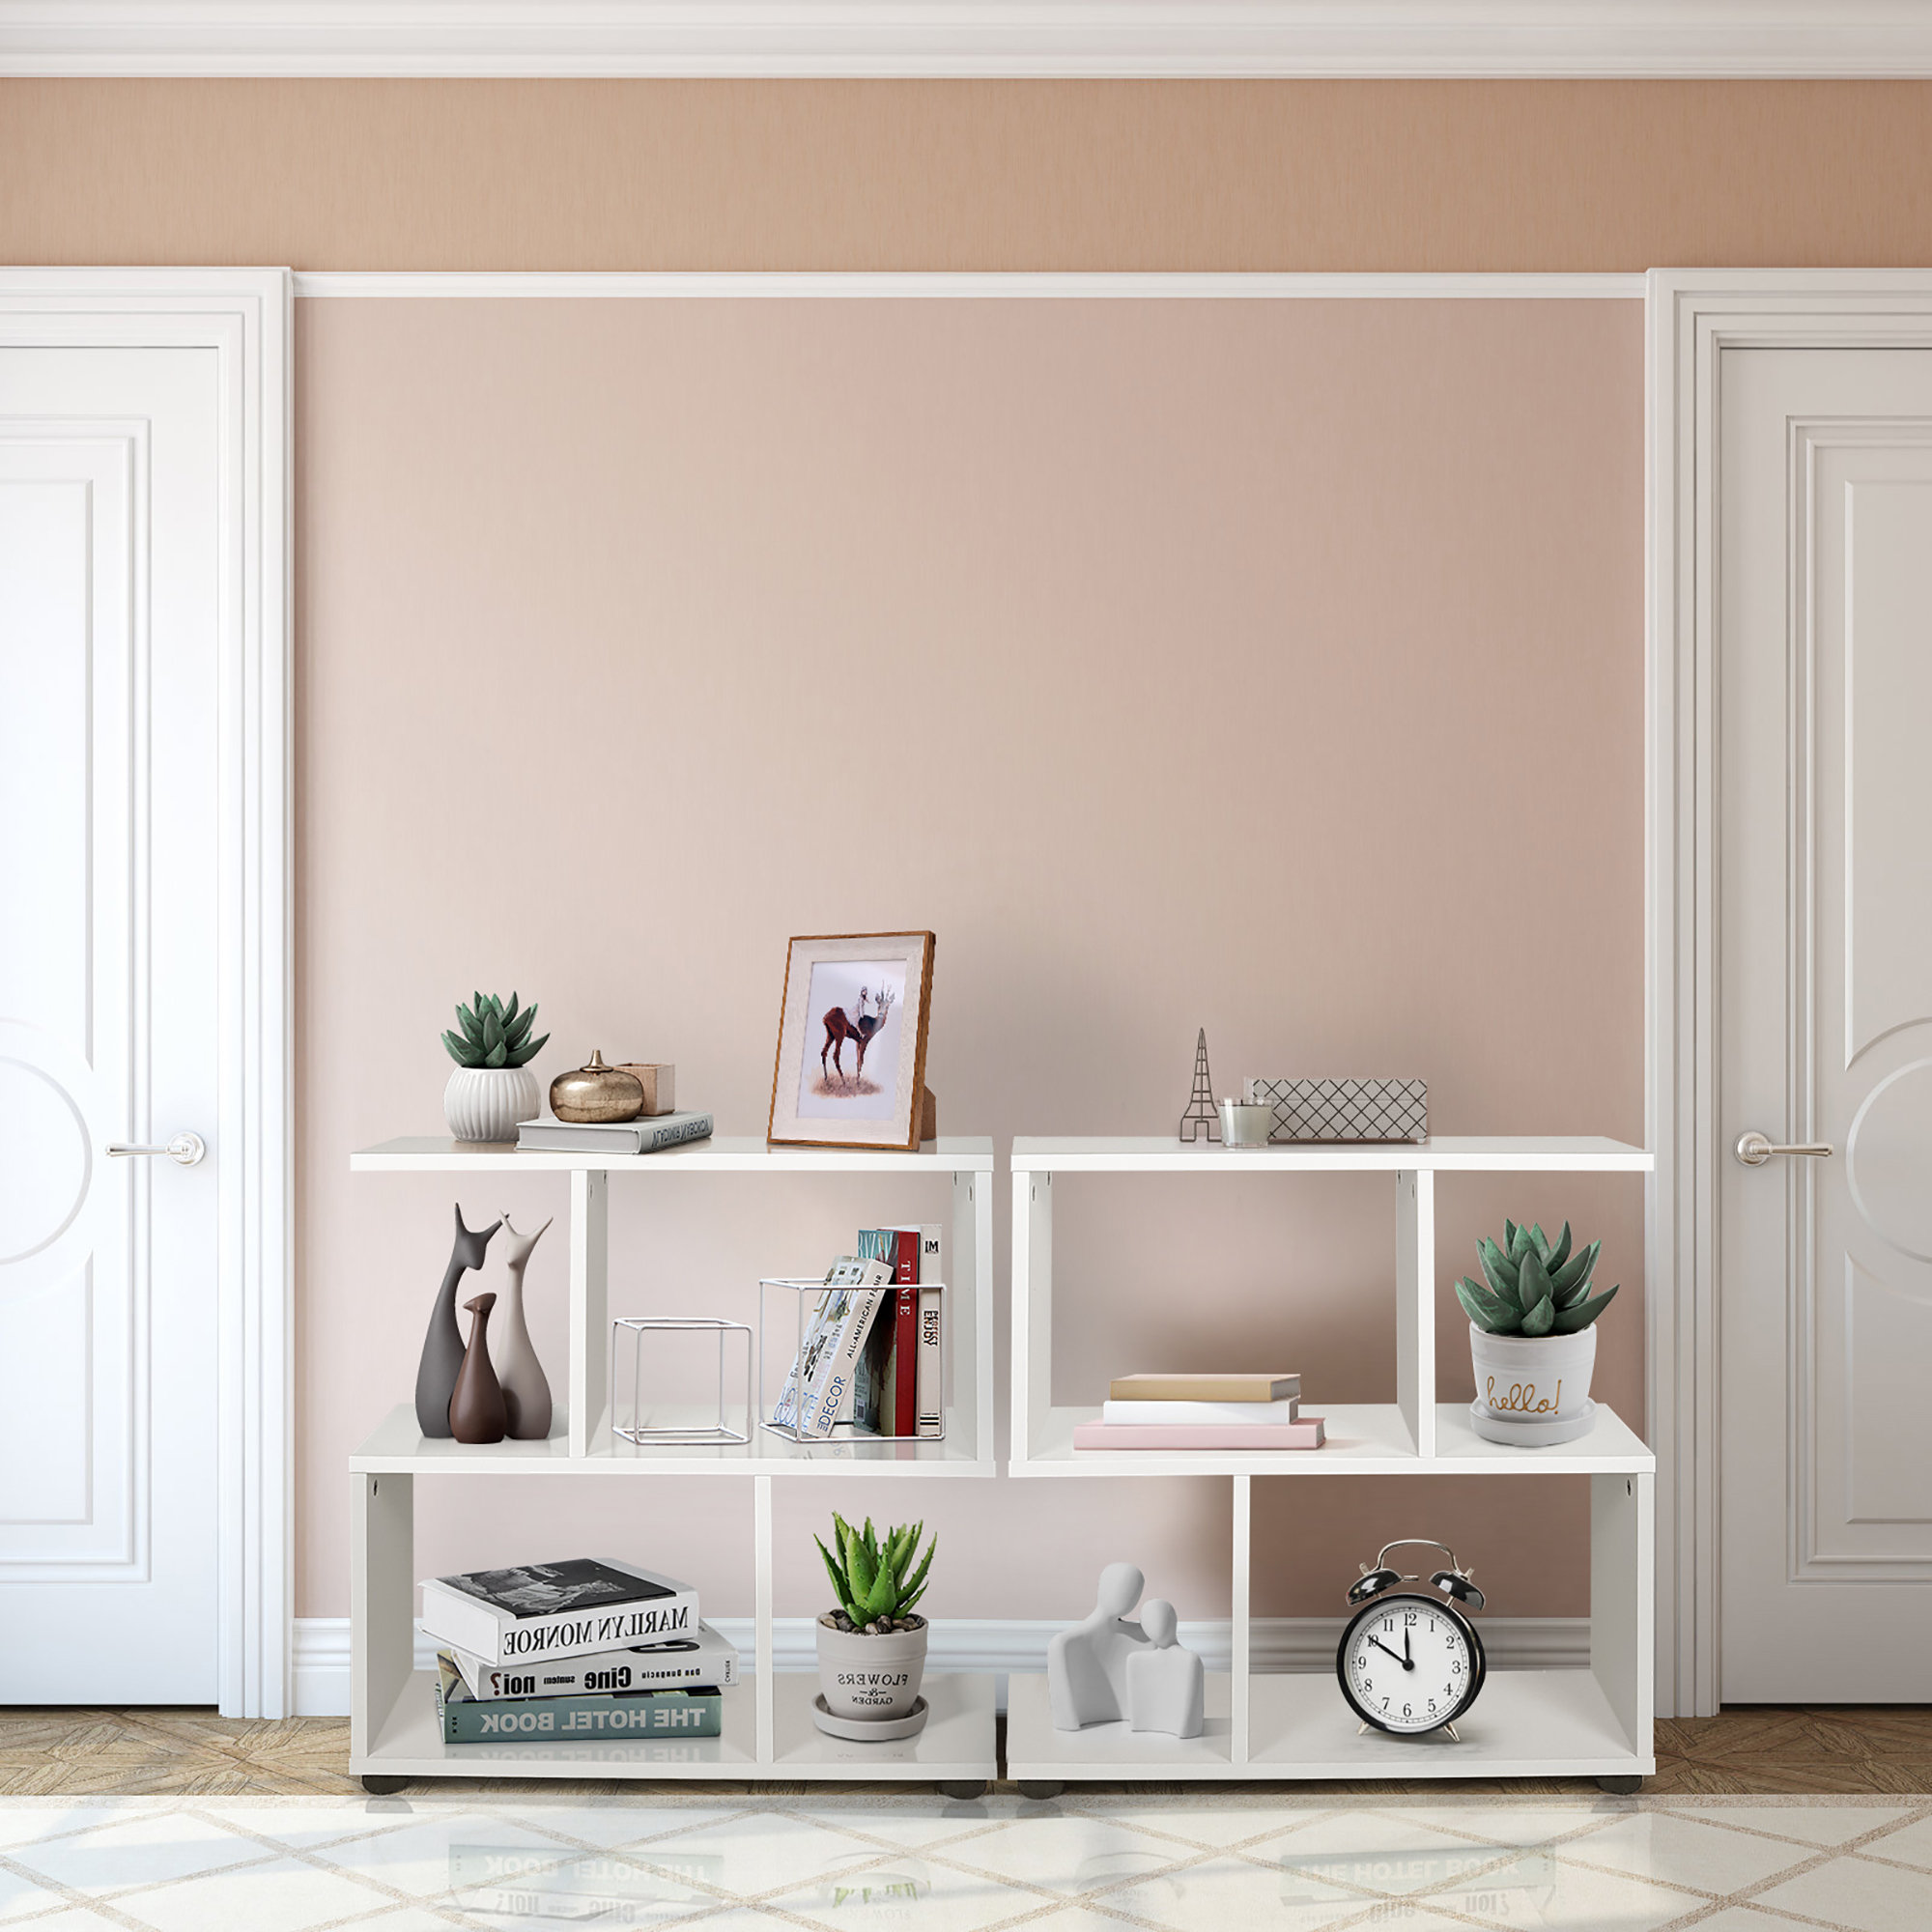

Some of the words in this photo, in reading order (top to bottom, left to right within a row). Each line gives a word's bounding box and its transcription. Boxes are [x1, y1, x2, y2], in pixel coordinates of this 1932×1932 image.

[899, 1260, 911, 1317] TIME
[818, 1375, 846, 1427] DECOR
[1487, 1376, 1562, 1415] hello!
[1383, 1619, 1394, 1632] 11
[1404, 1612, 1417, 1626] 12
[1429, 1619, 1435, 1633] 1
[1445, 1635, 1455, 1650] 2
[1357, 1656, 1367, 1670] 9
[1451, 1660, 1462, 1675] 3
[1364, 1678, 1373, 1691] 8
[1443, 1683, 1454, 1696] 4
[1381, 1696, 1390, 1711] 7
[1403, 1702, 1412, 1718] 6
[1427, 1698, 1436, 1713] 5
